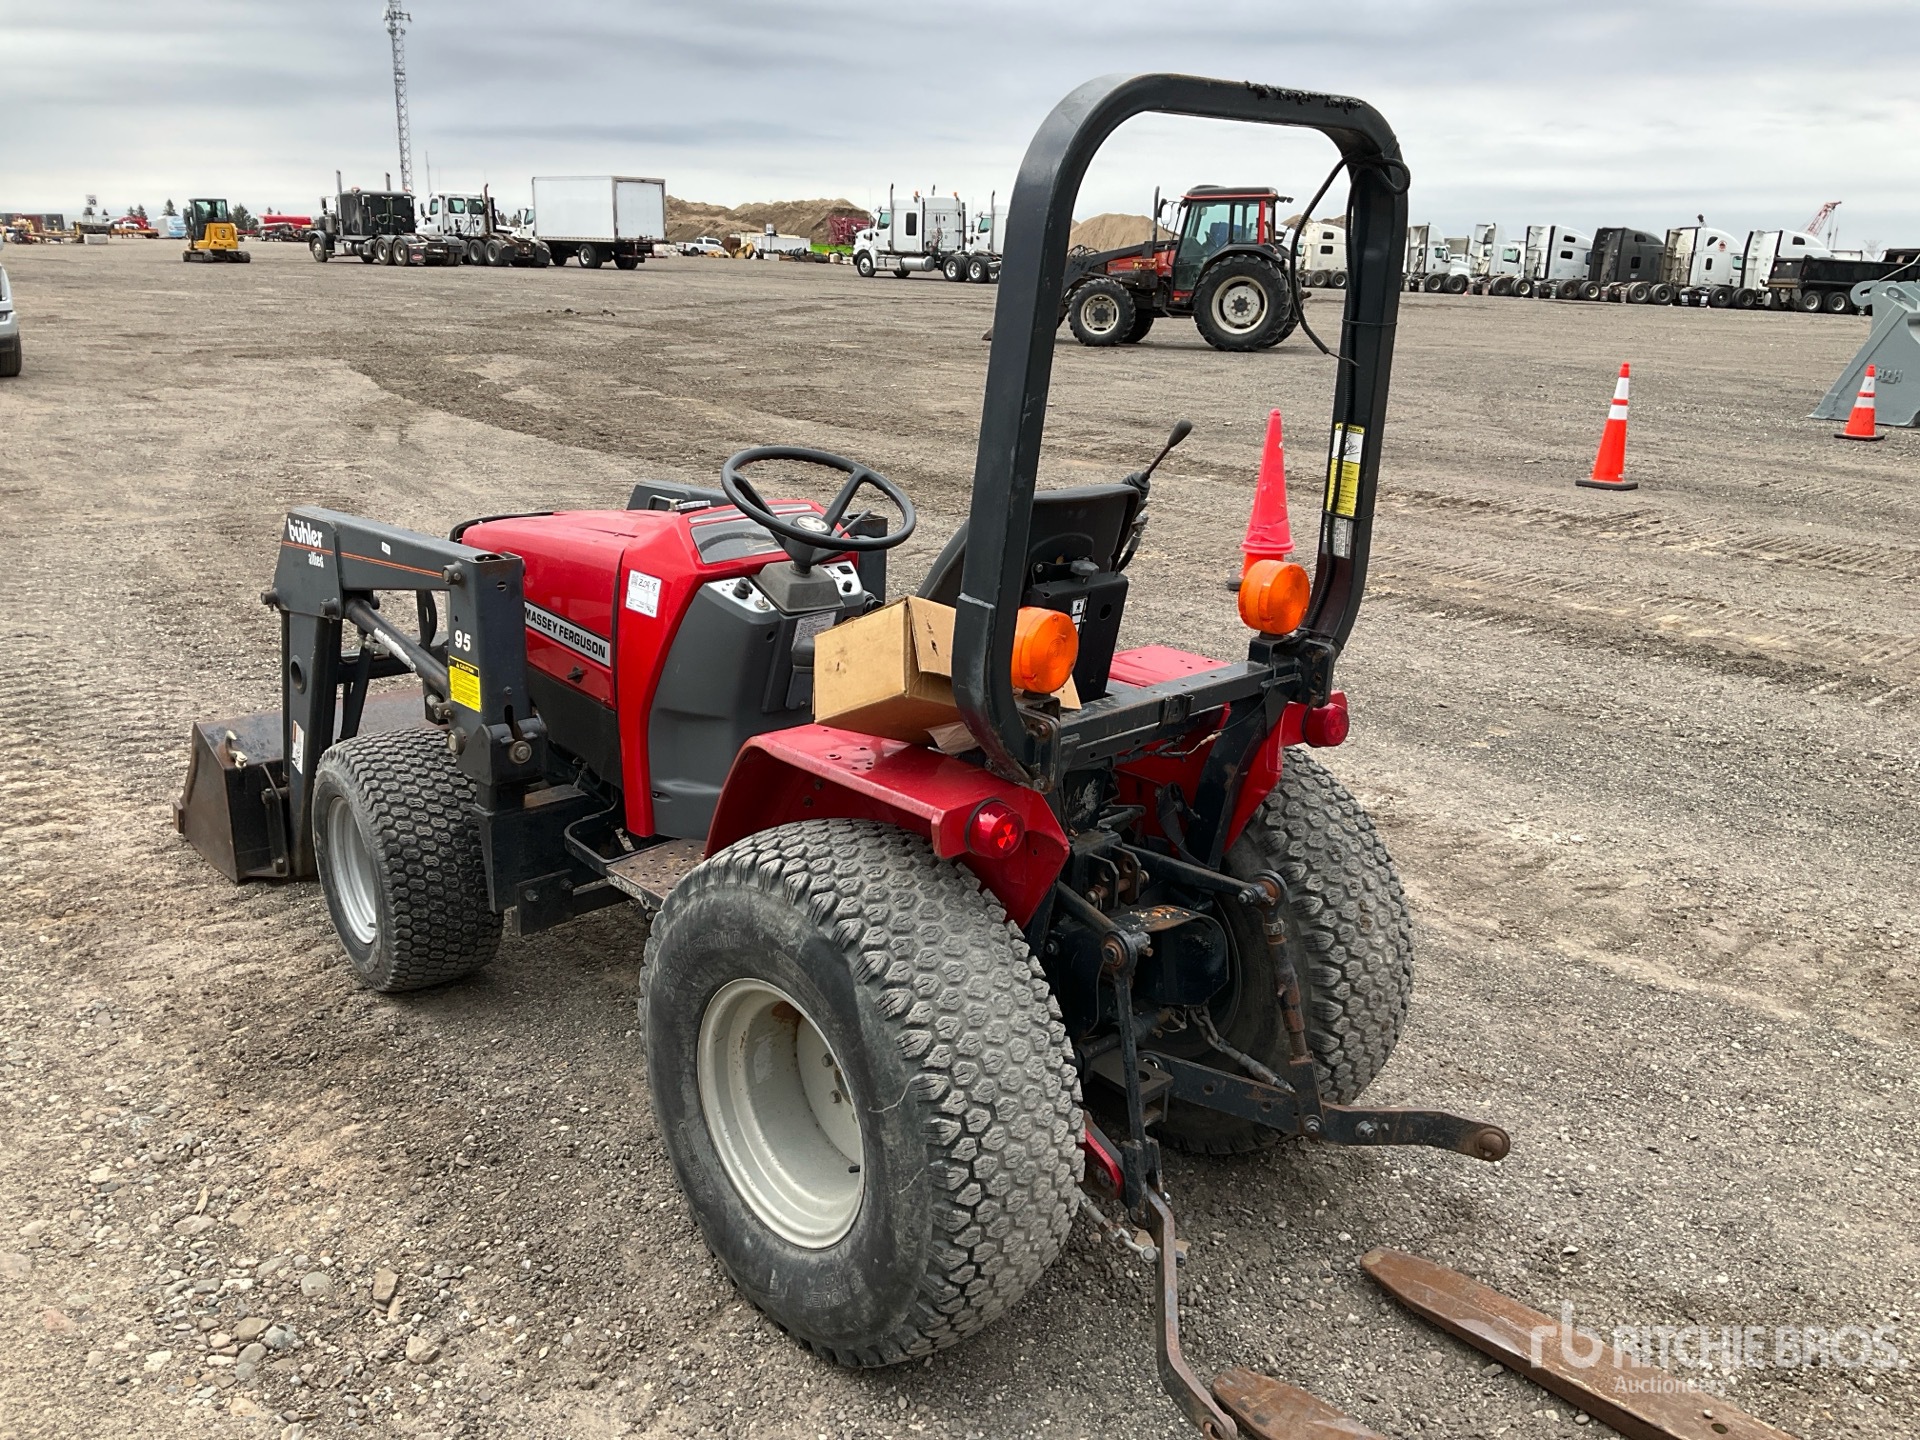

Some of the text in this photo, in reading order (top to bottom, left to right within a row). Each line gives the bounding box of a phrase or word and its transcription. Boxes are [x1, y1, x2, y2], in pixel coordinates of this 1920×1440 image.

[288, 517, 323, 548] bühler
[454, 629, 471, 651] 95
[526, 607, 606, 658] MASSEY FERGUSON
